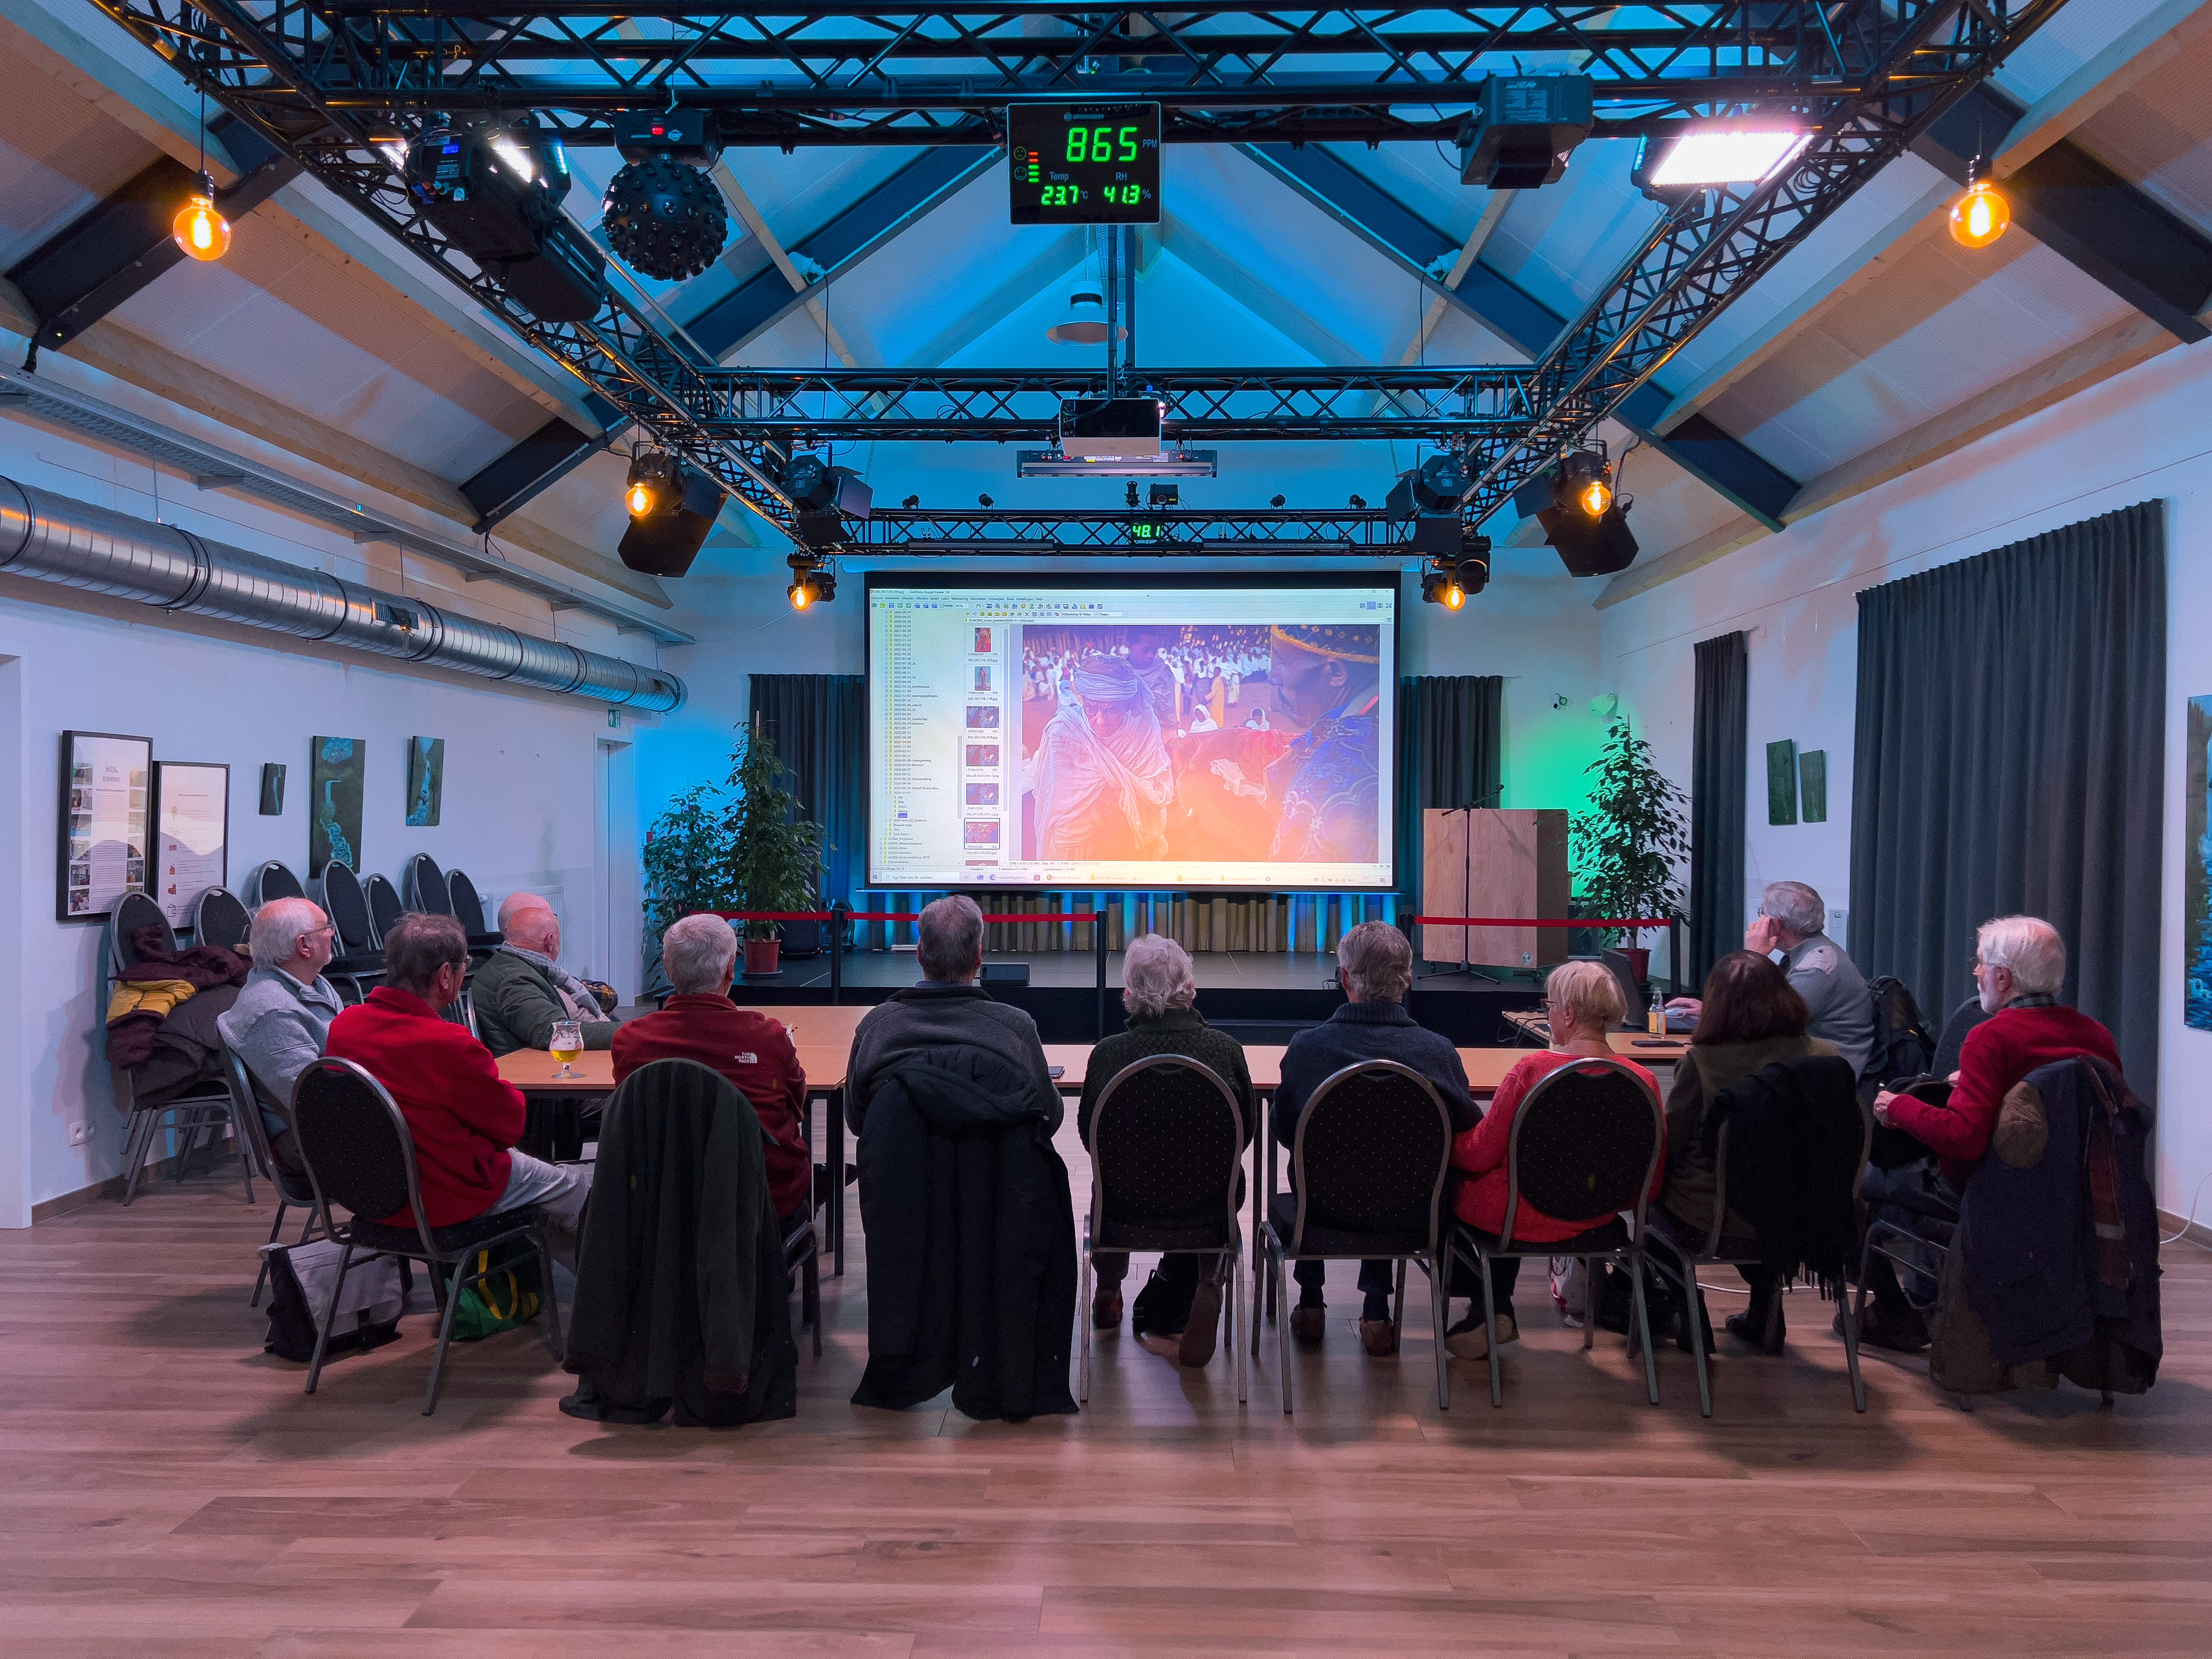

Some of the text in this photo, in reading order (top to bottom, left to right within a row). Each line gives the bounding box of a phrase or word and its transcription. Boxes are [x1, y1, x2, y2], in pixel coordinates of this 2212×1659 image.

[1066, 126, 1158, 162] 865 PPM
[1049, 171, 1069, 182] Temp
[1115, 172, 1127, 181] RH
[1041, 185, 1080, 206] 23.7
[1103, 184, 1152, 205] 41.3 %
[1132, 524, 1161, 537] 48.1
